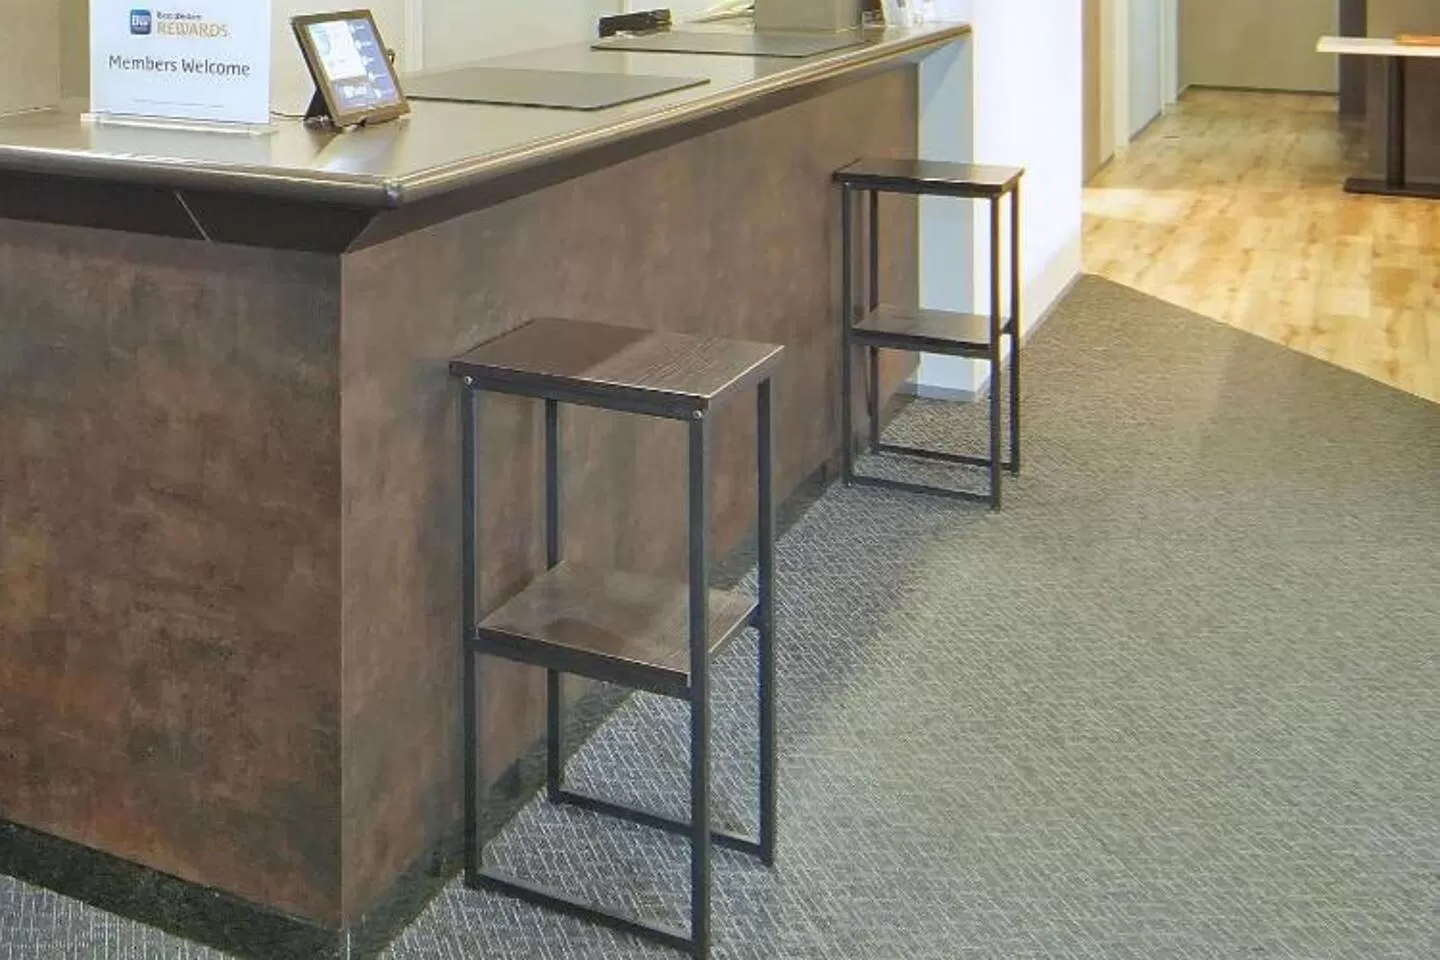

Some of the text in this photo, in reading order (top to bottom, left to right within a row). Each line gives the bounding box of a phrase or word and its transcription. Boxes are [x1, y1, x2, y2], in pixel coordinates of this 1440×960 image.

[156, 21, 231, 39] REWARDS
[109, 55, 251, 77] Members Welcome
